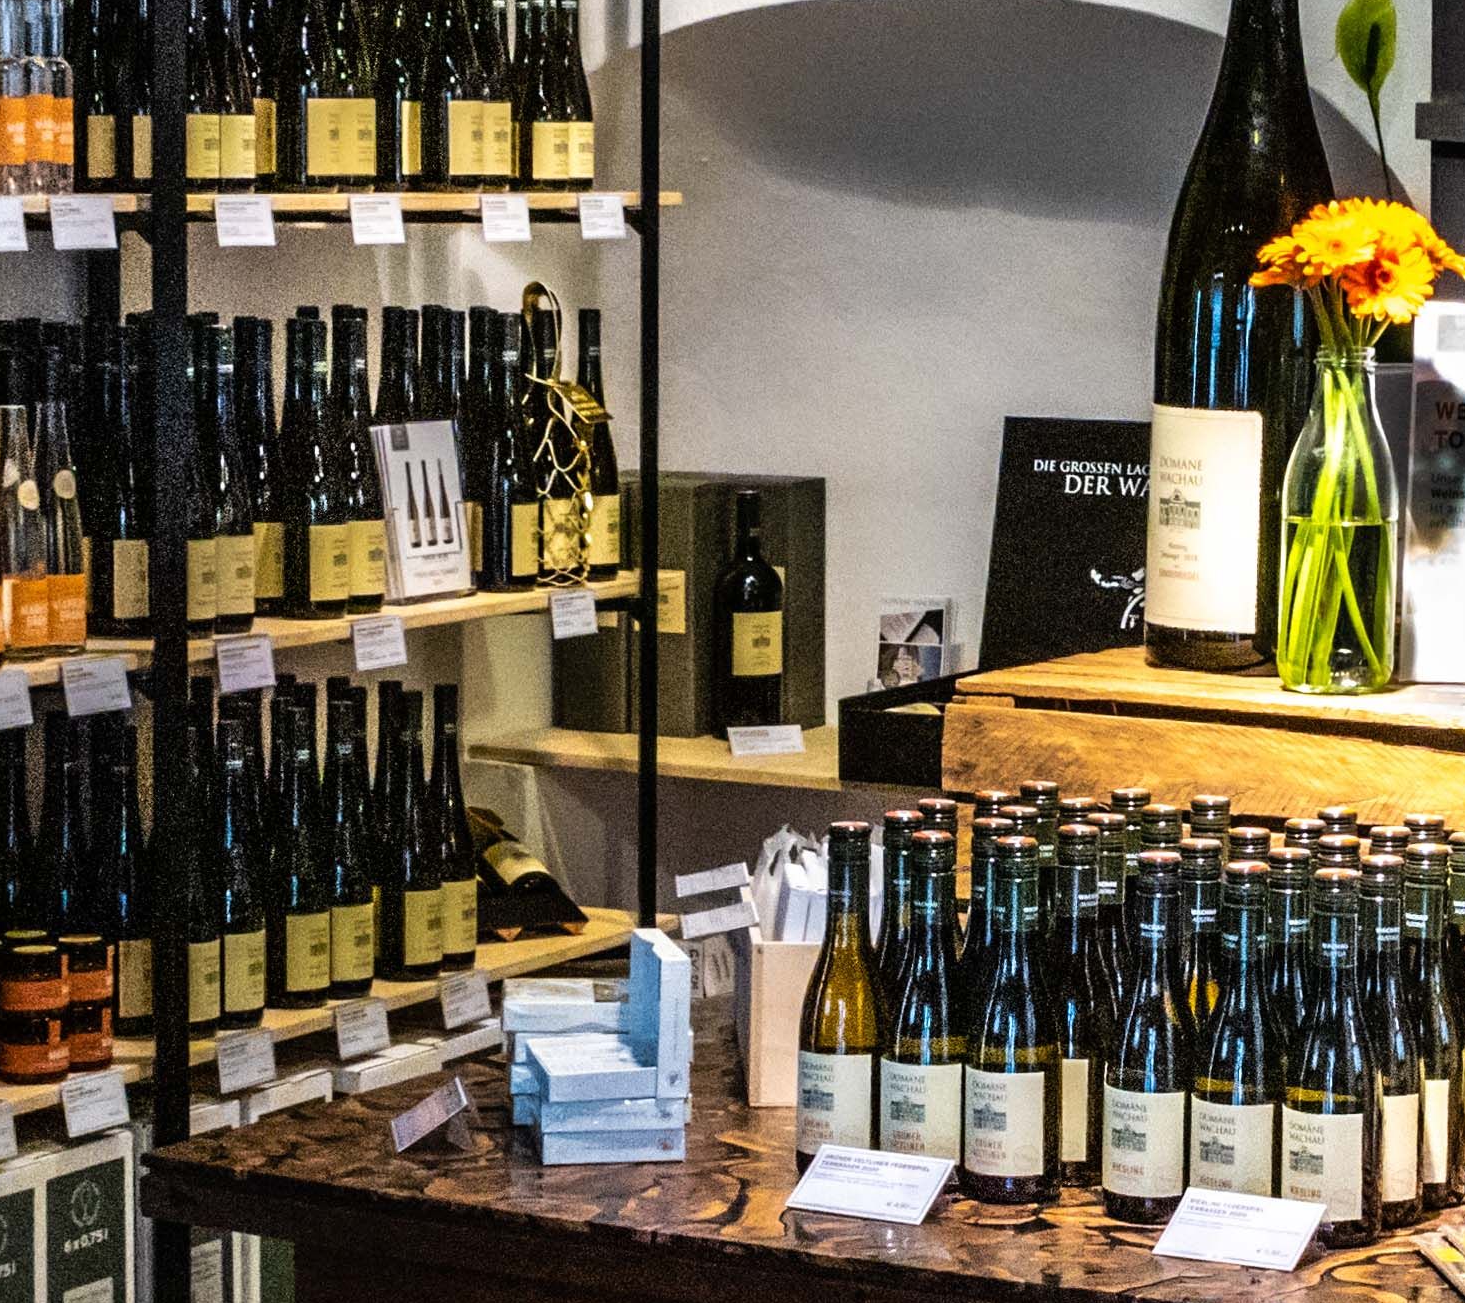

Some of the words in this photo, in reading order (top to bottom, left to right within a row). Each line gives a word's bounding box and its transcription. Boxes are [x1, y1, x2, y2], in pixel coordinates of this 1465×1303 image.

[1435, 430, 1465, 450] TO
[1034, 459, 1057, 472] DIE
[1060, 459, 1122, 475] GROSSEN
[1063, 473, 1112, 496] DER
